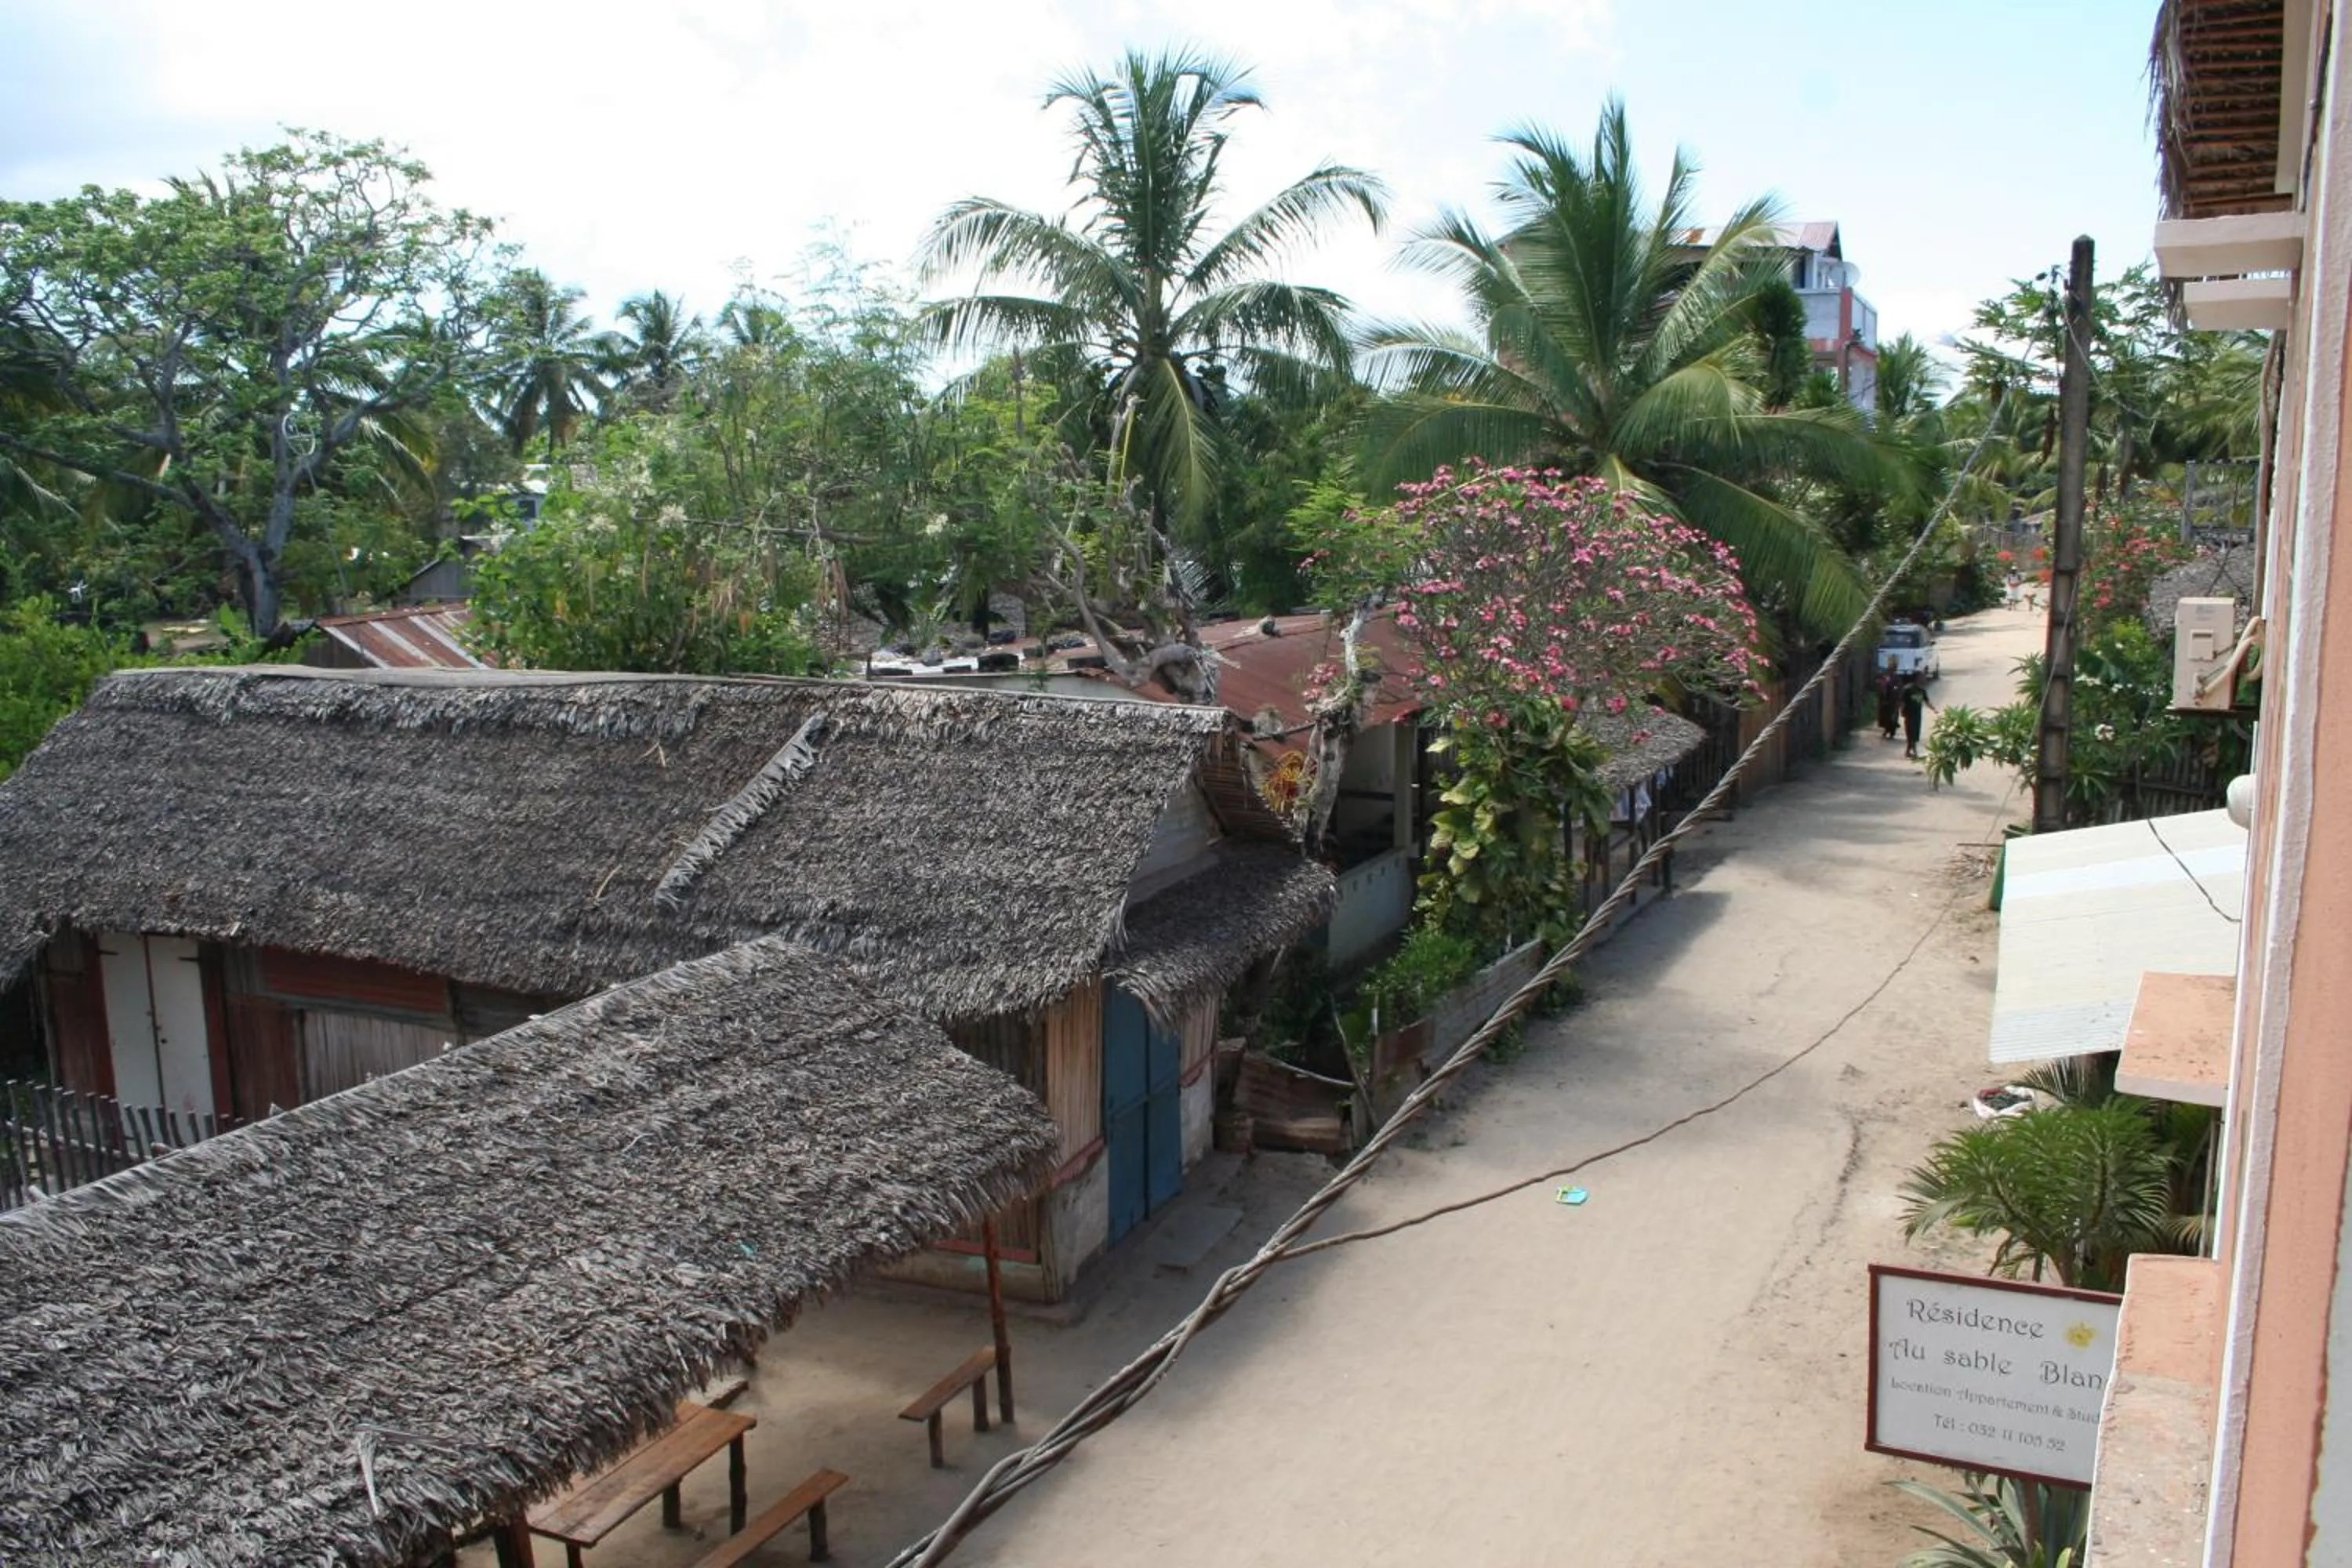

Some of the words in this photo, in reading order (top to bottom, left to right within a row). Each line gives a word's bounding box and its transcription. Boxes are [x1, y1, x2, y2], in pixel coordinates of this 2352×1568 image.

[1907, 1298, 2044, 1338] Résidence
[1889, 1338, 1926, 1360] Au
[1944, 1348, 2013, 1374] sable
[2039, 1360, 2109, 1390] Blan
